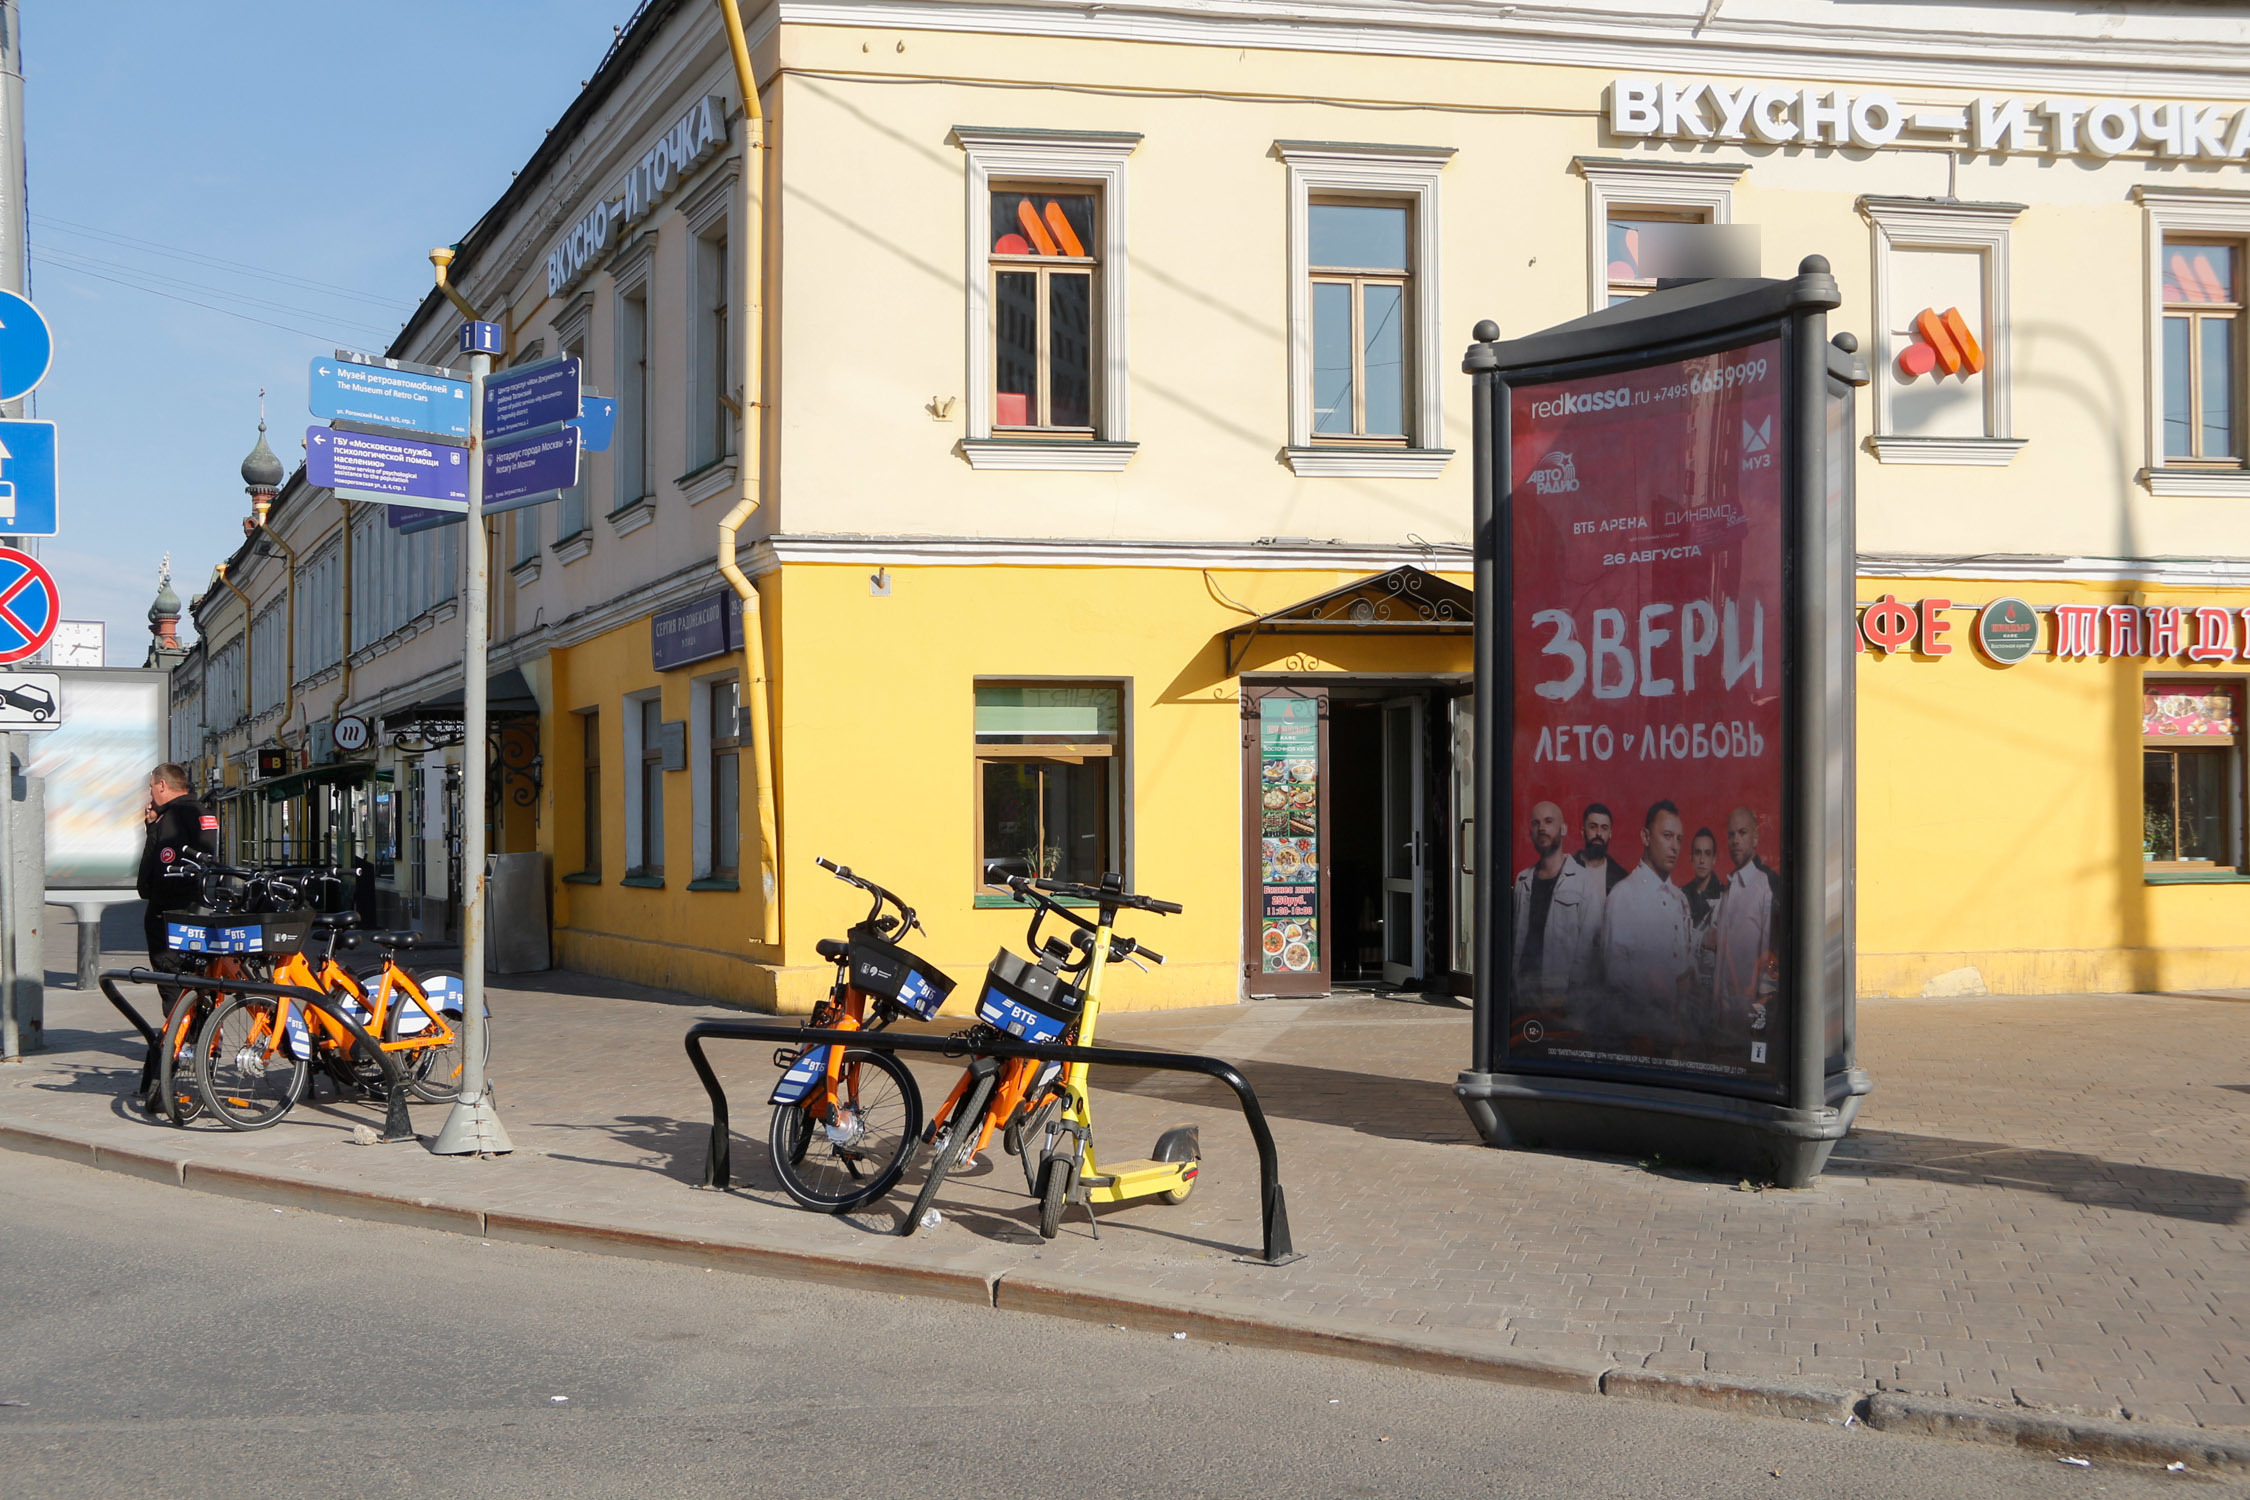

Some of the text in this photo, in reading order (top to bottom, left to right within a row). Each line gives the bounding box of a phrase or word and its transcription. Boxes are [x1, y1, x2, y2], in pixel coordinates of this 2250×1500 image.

[642, 95, 718, 203] ТОЧКА
[338, 368, 448, 394] Музей ретроавтомобилей
[1531, 387, 1650, 419] redkassa.ru
[1690, 358, 1767, 395] 6659999
[337, 381, 428, 402] The Museum of Retro Cars
[333, 437, 432, 458] ГБУ «Московская служба
[334, 447, 439, 467] психологической помощи
[496, 440, 564, 463] Нотариус города Москвы
[334, 455, 385, 468] населению»
[1742, 454, 1771, 471] МУЗ
[1526, 468, 1562, 483] АВТО
[1537, 479, 1580, 495] РАДИО
[1573, 520, 1595, 534] ВТБ
[1599, 516, 1648, 532] АРЕНА
[1603, 544, 1702, 566] 26 АВГУСТА
[656, 619, 676, 637] СЕРГИЯ
[1856, 594, 1952, 656] ФЕ
[2055, 604, 2250, 661] ТАНД
[1531, 595, 1765, 703] ЗВЕРИ
[1534, 720, 1764, 762] ЛЕТО ЛЮБОВЬ
[1263, 886, 1315, 894] Бизнес ланч
[187, 928, 206, 939] ВТБ
[231, 930, 246, 940] ВТБ
[920, 984, 936, 1000] ВТБ
[291, 1019, 303, 1029] ВТБ
[1011, 1005, 1037, 1026] ВТБ
[1528, 1026, 1540, 1035] 12+
[808, 1061, 825, 1072] ВТБ
